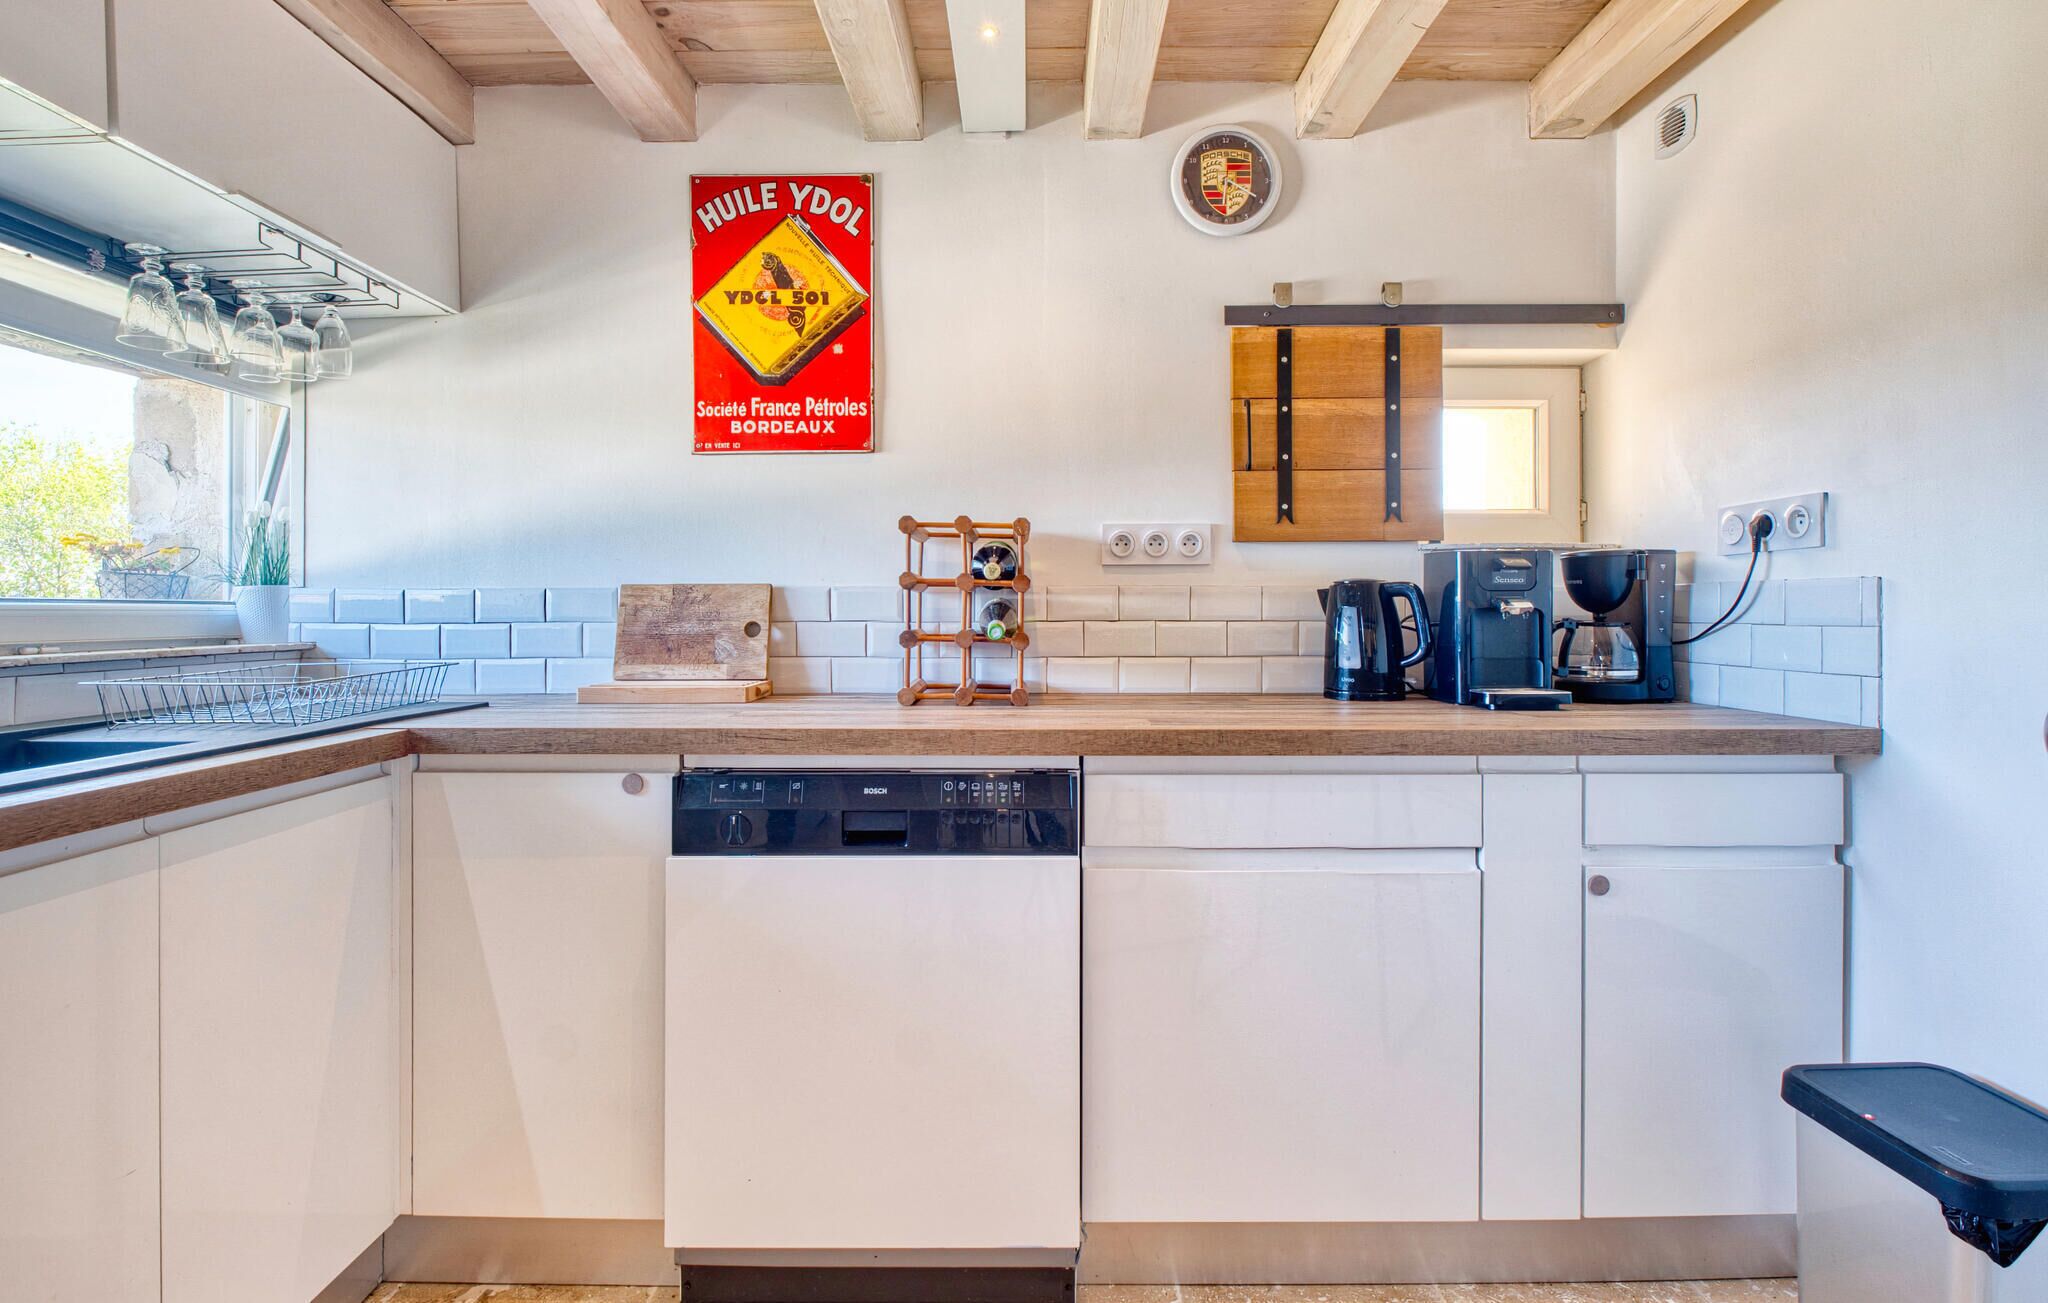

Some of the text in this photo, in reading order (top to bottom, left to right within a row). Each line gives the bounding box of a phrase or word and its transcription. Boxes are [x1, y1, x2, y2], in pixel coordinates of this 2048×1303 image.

[1202, 151, 1250, 161] PORSCHE
[696, 182, 865, 237] HUILE YDOL
[785, 222, 810, 249] NOUVELLE
[809, 249, 826, 266] HUILE
[724, 290, 830, 306] YDOL 501
[696, 396, 868, 417] Société France Pétroles
[730, 420, 836, 434] BORDEAUX
